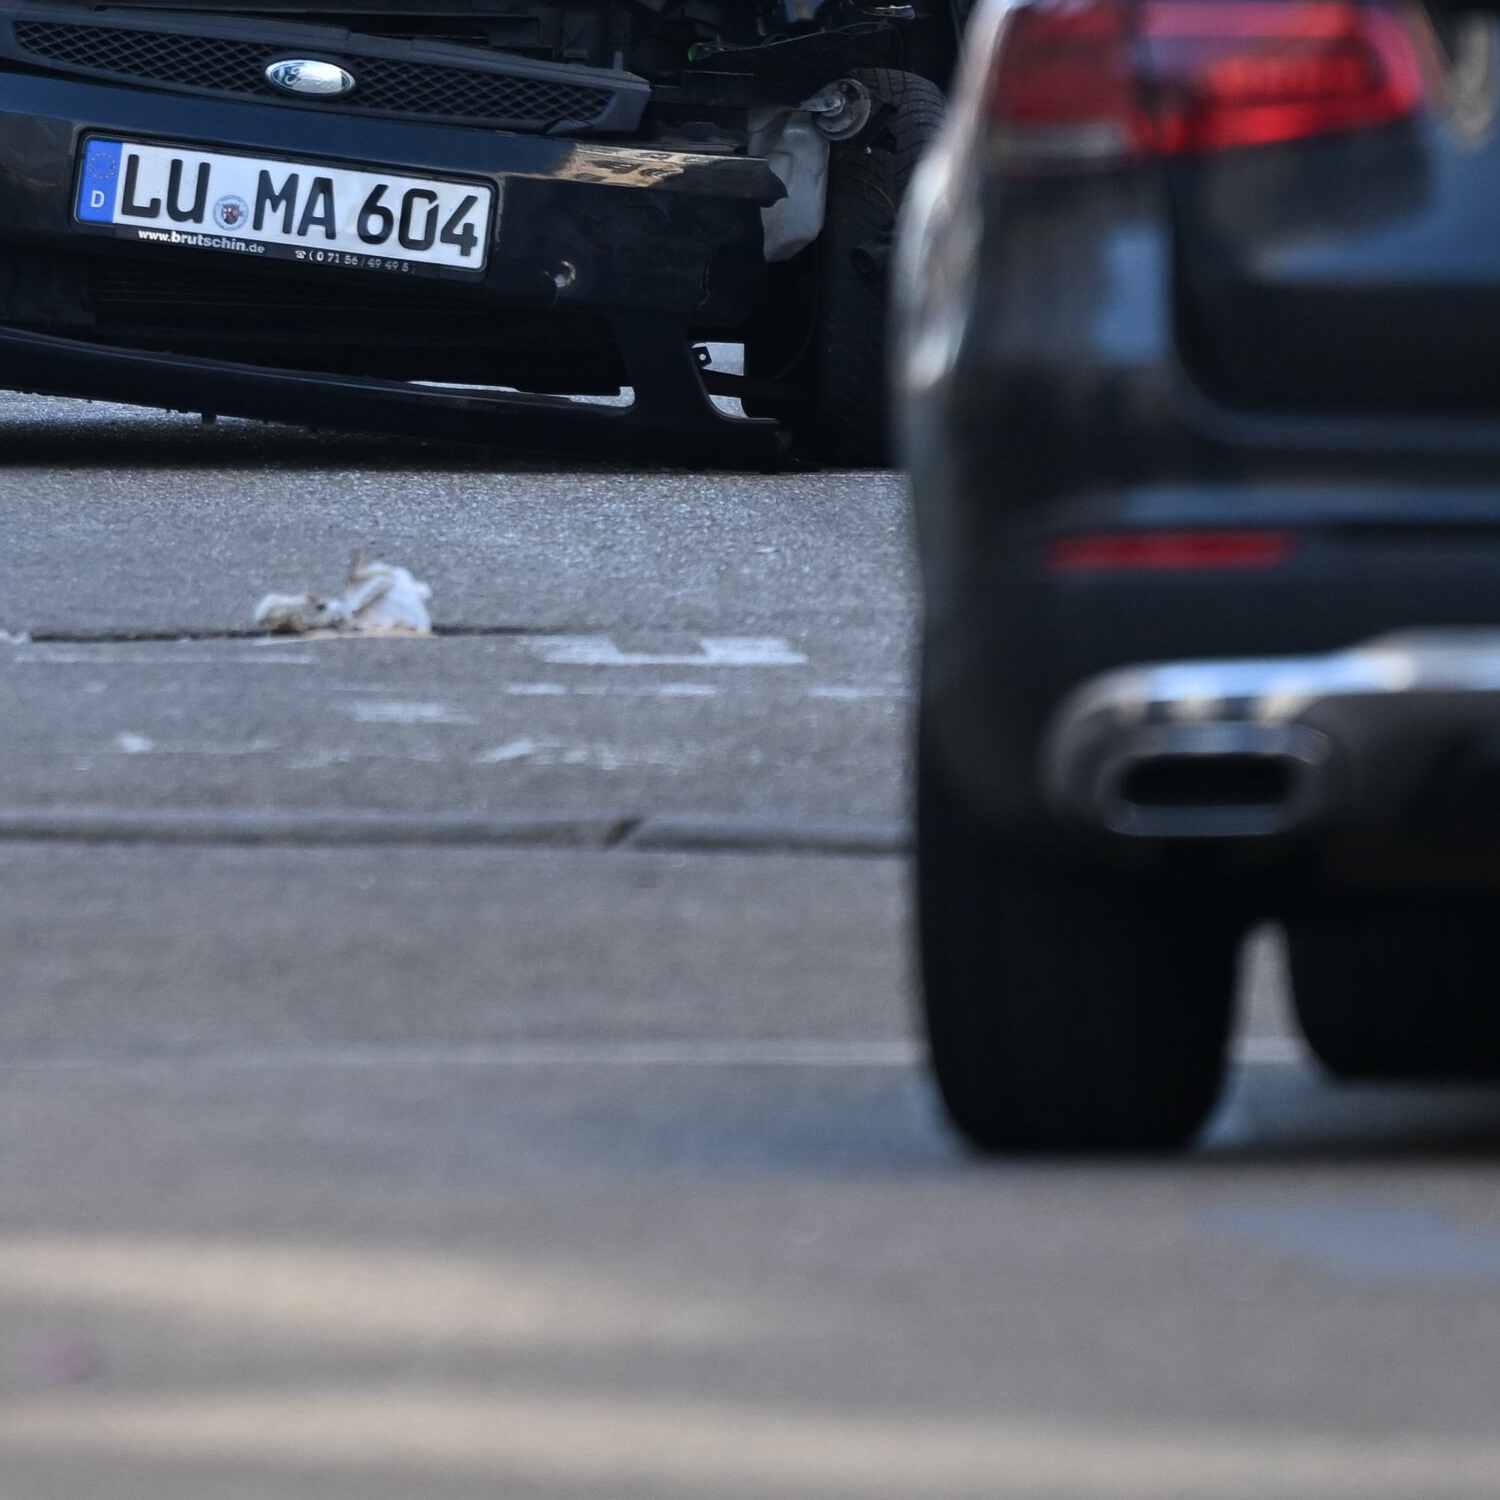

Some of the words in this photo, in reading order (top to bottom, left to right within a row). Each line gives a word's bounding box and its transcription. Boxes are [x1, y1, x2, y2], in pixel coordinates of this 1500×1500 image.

[90, 190, 105, 208] D
[121, 153, 211, 224] LU
[252, 169, 337, 240] MA
[357, 183, 478, 257] 604
[138, 230, 265, 254] www.brutschin.de
